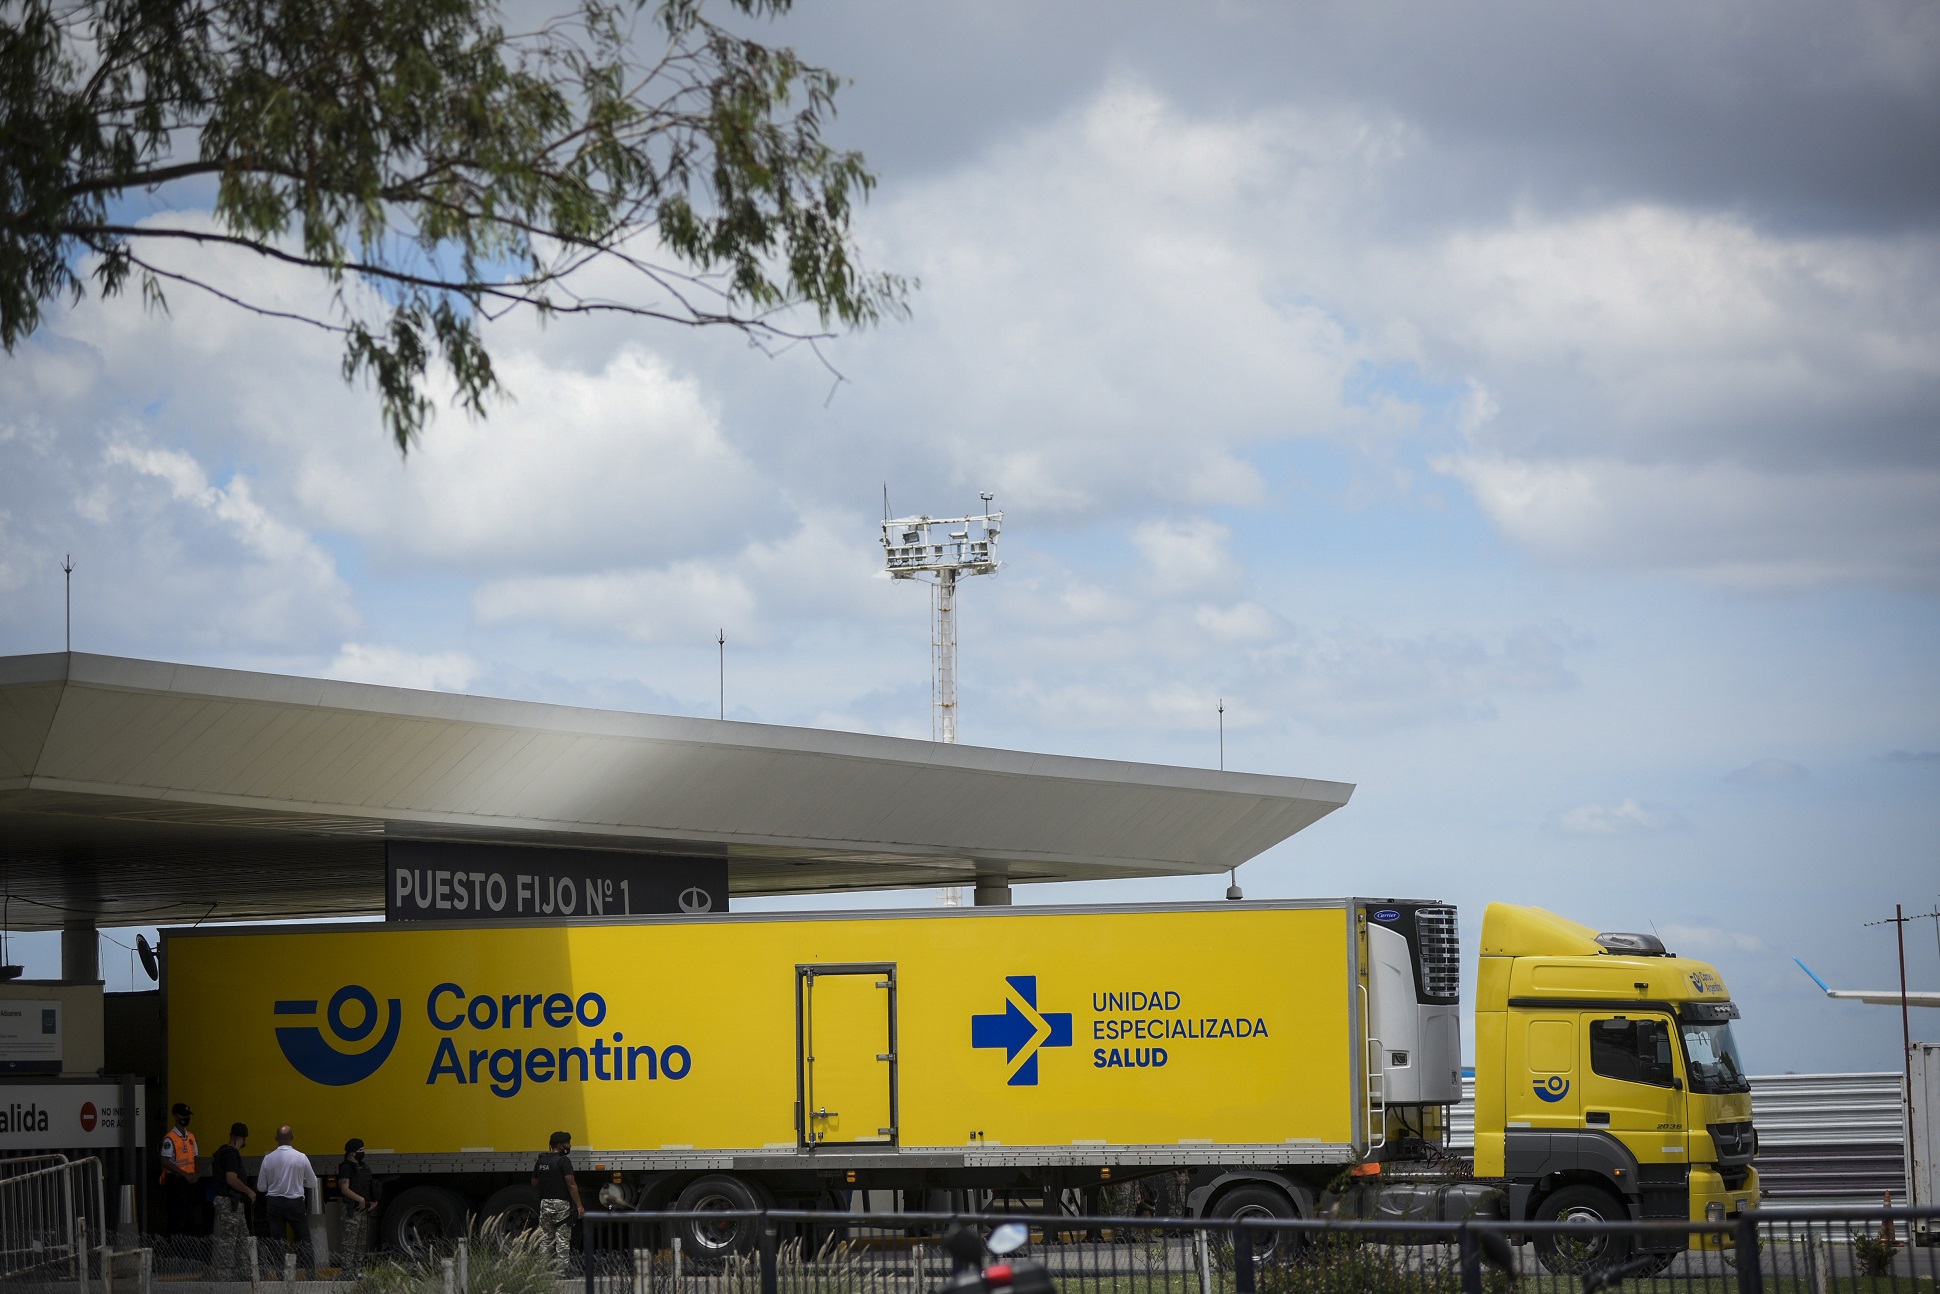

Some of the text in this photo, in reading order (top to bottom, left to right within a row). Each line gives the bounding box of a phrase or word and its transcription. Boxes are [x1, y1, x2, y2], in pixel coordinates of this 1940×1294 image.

[396, 868, 507, 912] PUESTO
[517, 875, 577, 916] FIJO
[620, 879, 630, 916] 1
[427, 982, 607, 1031] Correo
[1092, 991, 1181, 1012] UNIDAD
[1093, 1018, 1269, 1040] ESPECIALIZADA
[426, 1032, 692, 1099] Argentino
[1093, 1047, 1168, 1068] SALUD
[101, 1107, 112, 1116] NO
[101, 1119, 115, 1128] POR
